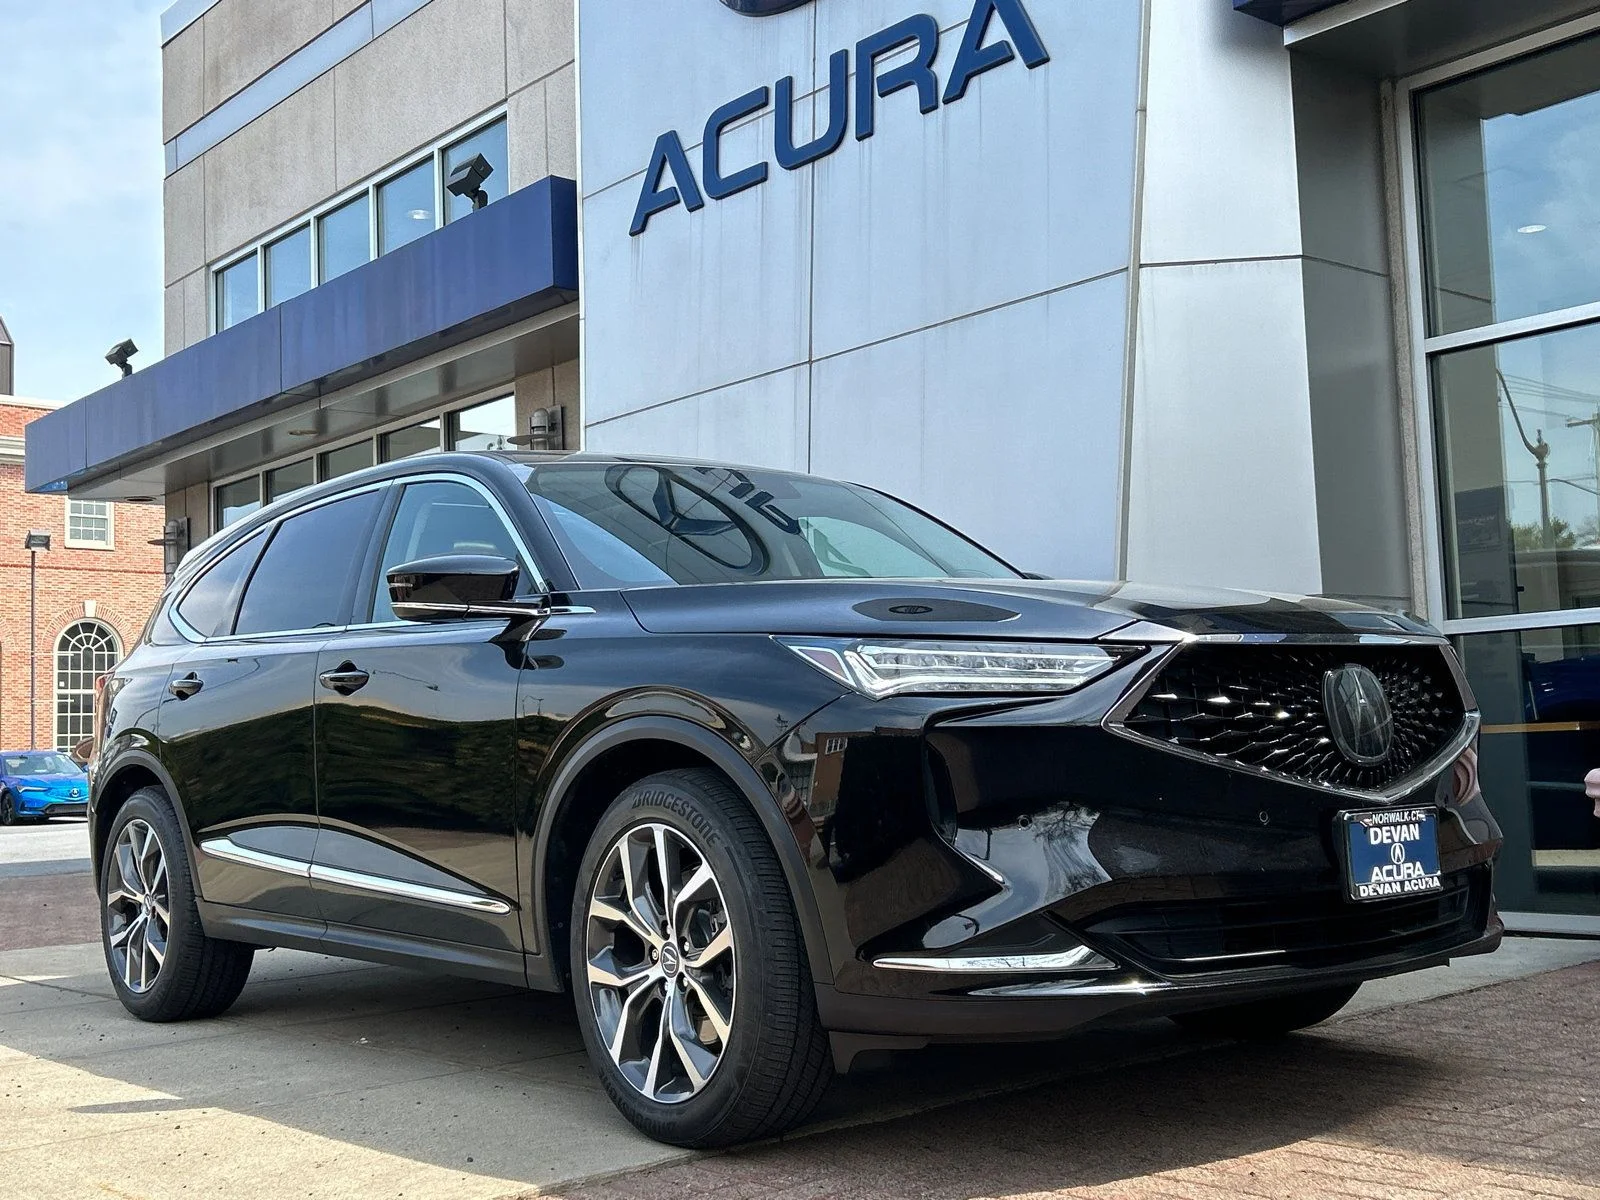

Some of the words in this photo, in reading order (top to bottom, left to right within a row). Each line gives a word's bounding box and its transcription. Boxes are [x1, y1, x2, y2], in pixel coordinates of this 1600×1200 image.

[629, 0, 1050, 236] ACURA
[632, 790, 721, 848] BRIDGESTONE
[1370, 824, 1419, 844] DEVAN
[1371, 861, 1425, 882] ACURA
[1360, 882, 1401, 897] DEVAN
[1404, 876, 1440, 891] ACURA
